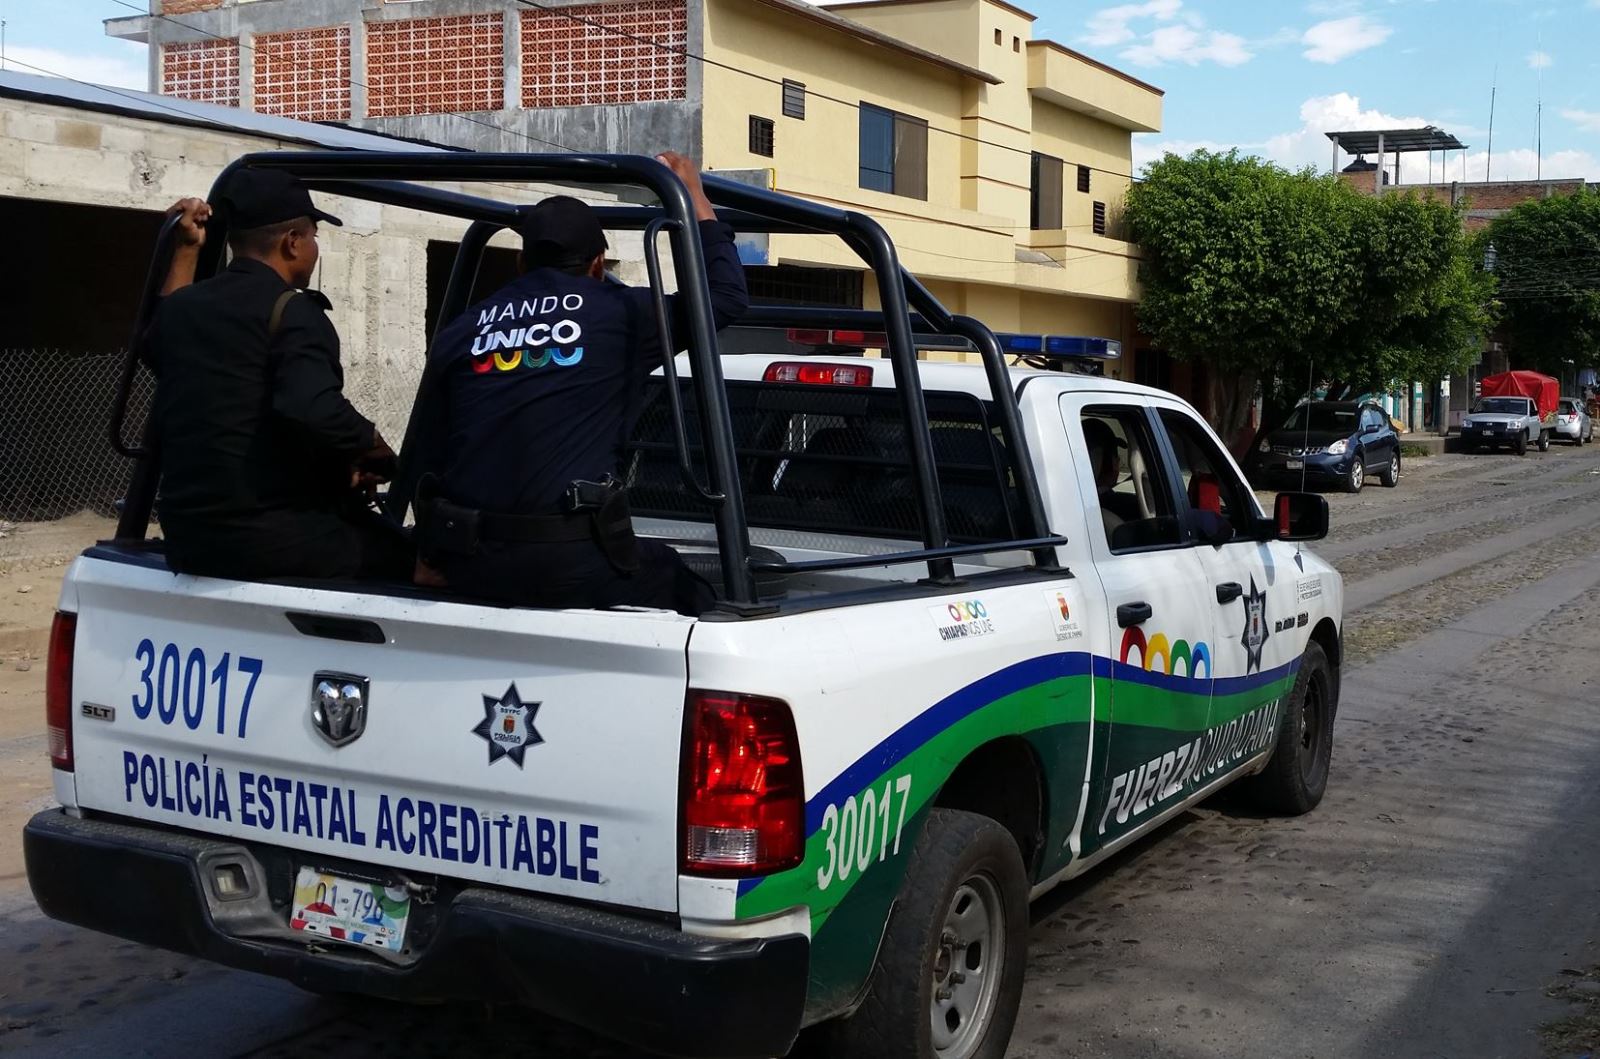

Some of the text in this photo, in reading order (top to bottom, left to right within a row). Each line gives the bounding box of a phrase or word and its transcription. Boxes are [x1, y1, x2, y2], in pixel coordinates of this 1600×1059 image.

[471, 319, 582, 356] ÚNICO
[477, 293, 584, 326] MANDO
[939, 624, 968, 641] CHIAPAS
[82, 705, 111, 718] SLT
[131, 638, 263, 739] 30017
[123, 751, 601, 884] POLICÍA ESTATAL ACREDITABLE
[1099, 737, 1202, 835] FUERZA
[817, 773, 912, 891] 30017
